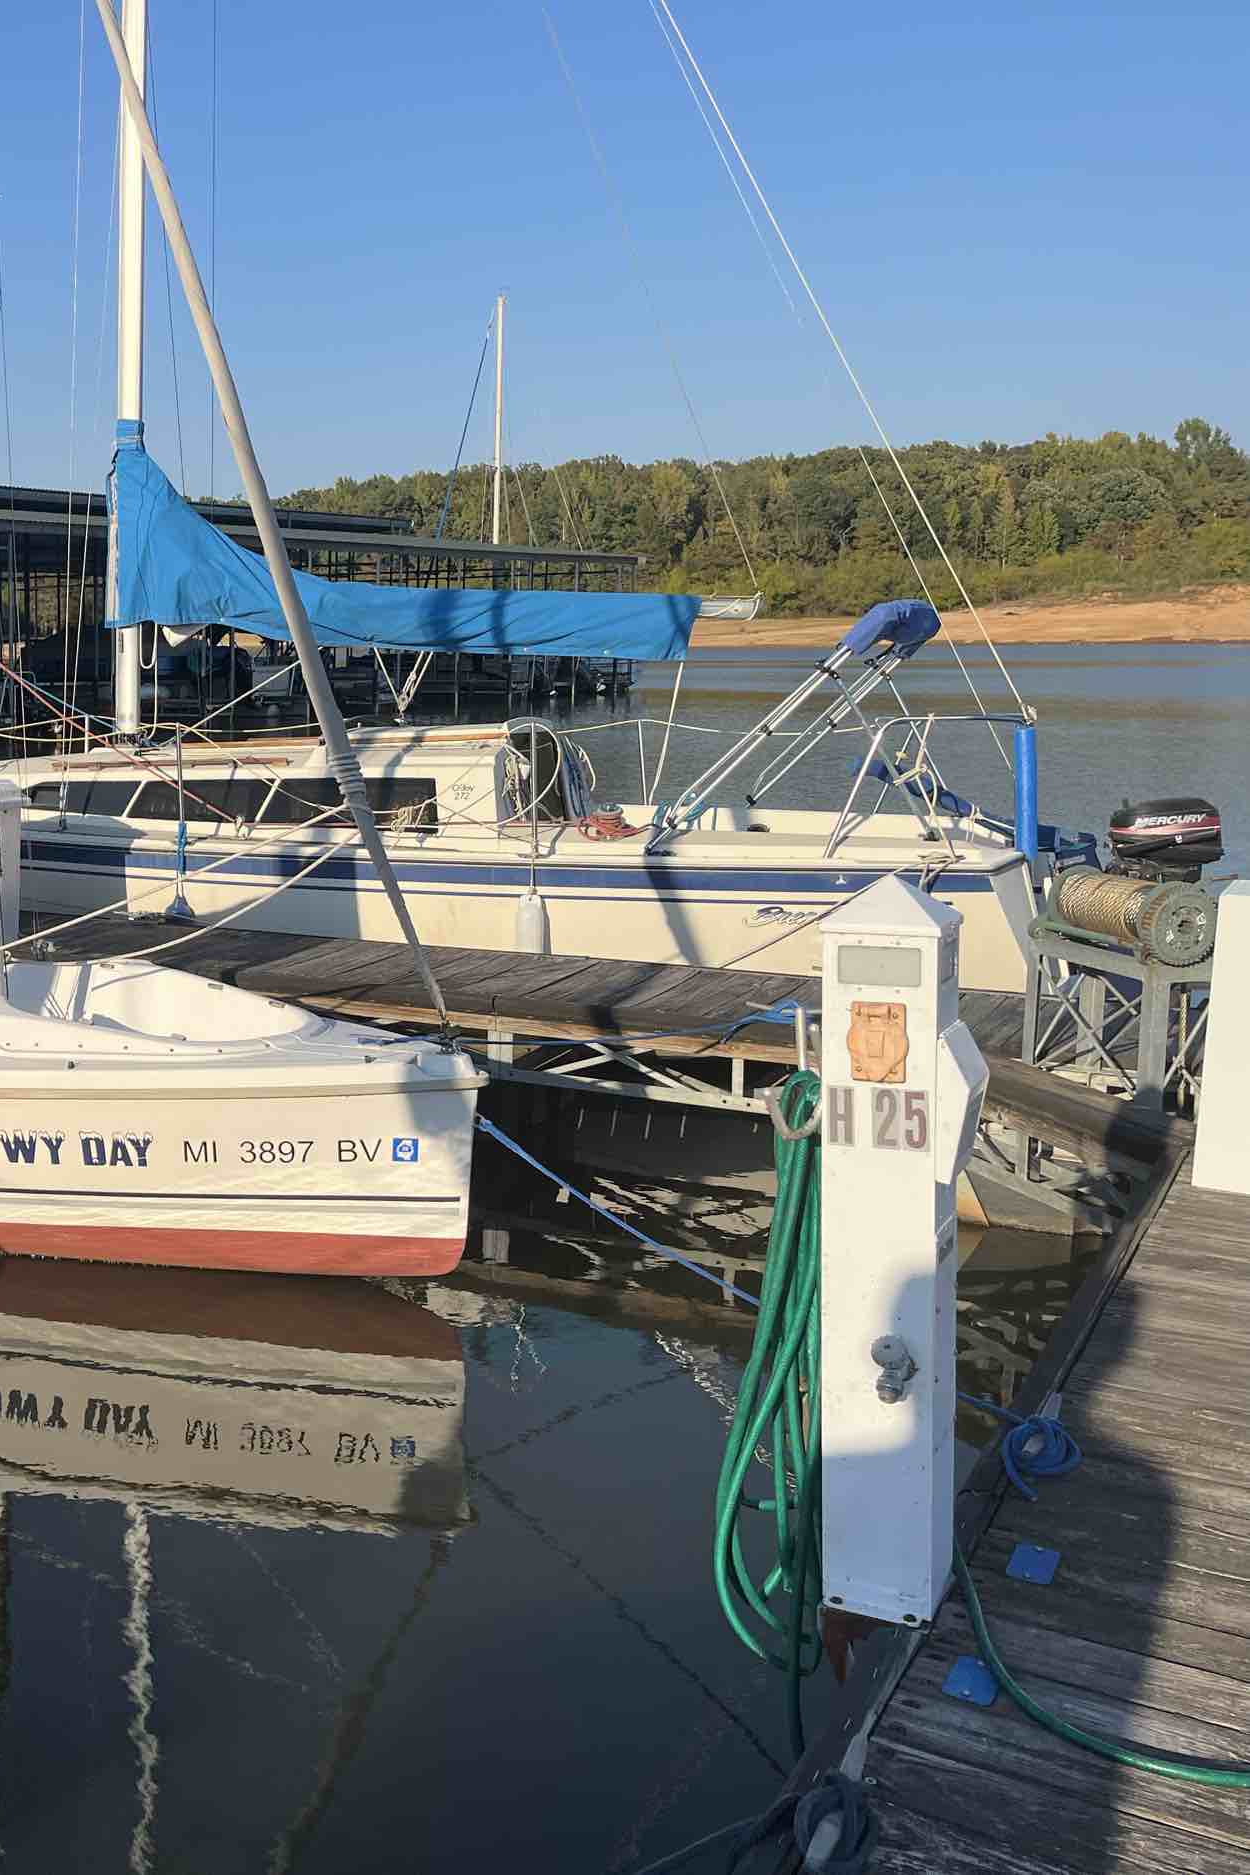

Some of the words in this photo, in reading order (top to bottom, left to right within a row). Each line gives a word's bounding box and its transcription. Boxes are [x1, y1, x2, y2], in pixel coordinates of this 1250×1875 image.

[1134, 814, 1206, 828] MERCURY
[828, 1087, 854, 1145] H
[874, 1088, 927, 1149] 25
[79, 1130, 153, 1167] DAY
[183, 1140, 218, 1163] MI
[239, 1140, 314, 1163] 3897
[337, 1139, 382, 1162] BV
